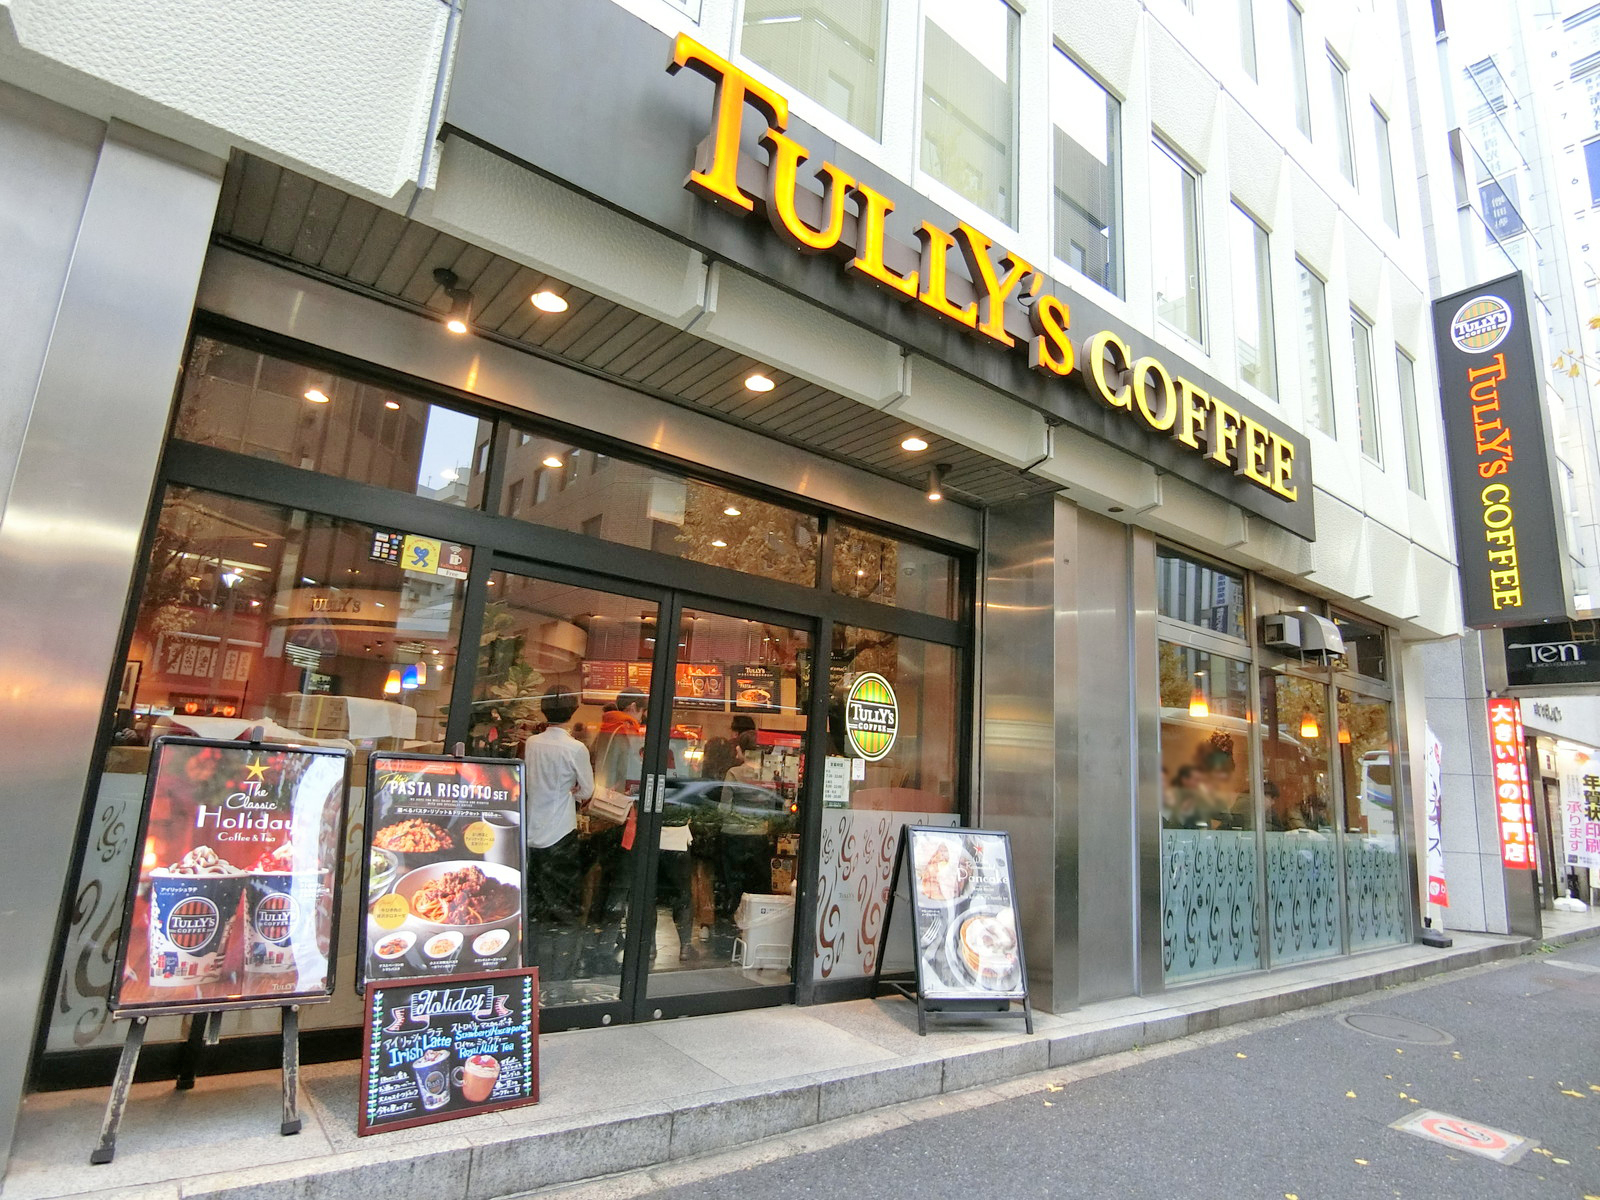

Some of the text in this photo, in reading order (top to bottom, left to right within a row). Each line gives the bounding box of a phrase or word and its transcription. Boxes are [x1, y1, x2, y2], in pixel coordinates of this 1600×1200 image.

[668, 32, 1298, 502] TULLY'S COFFEE
[1467, 353, 1522, 610] TULLY'S COFFEE
[850, 703, 895, 725] TULLY'S
[858, 723, 887, 732] COFFEE
[243, 781, 268, 797] The
[390, 781, 509, 800] PASTA RISOTTO SET
[226, 792, 277, 810] Classic
[197, 805, 297, 836] Holiday
[1567, 800, 1583, 851] 承ります
[171, 916, 215, 928] TULLY'S
[416, 989, 485, 1017] Holiday
[423, 1034, 452, 1050] Latte
[500, 1042, 514, 1052] Tea
[389, 1040, 424, 1067] Irish
